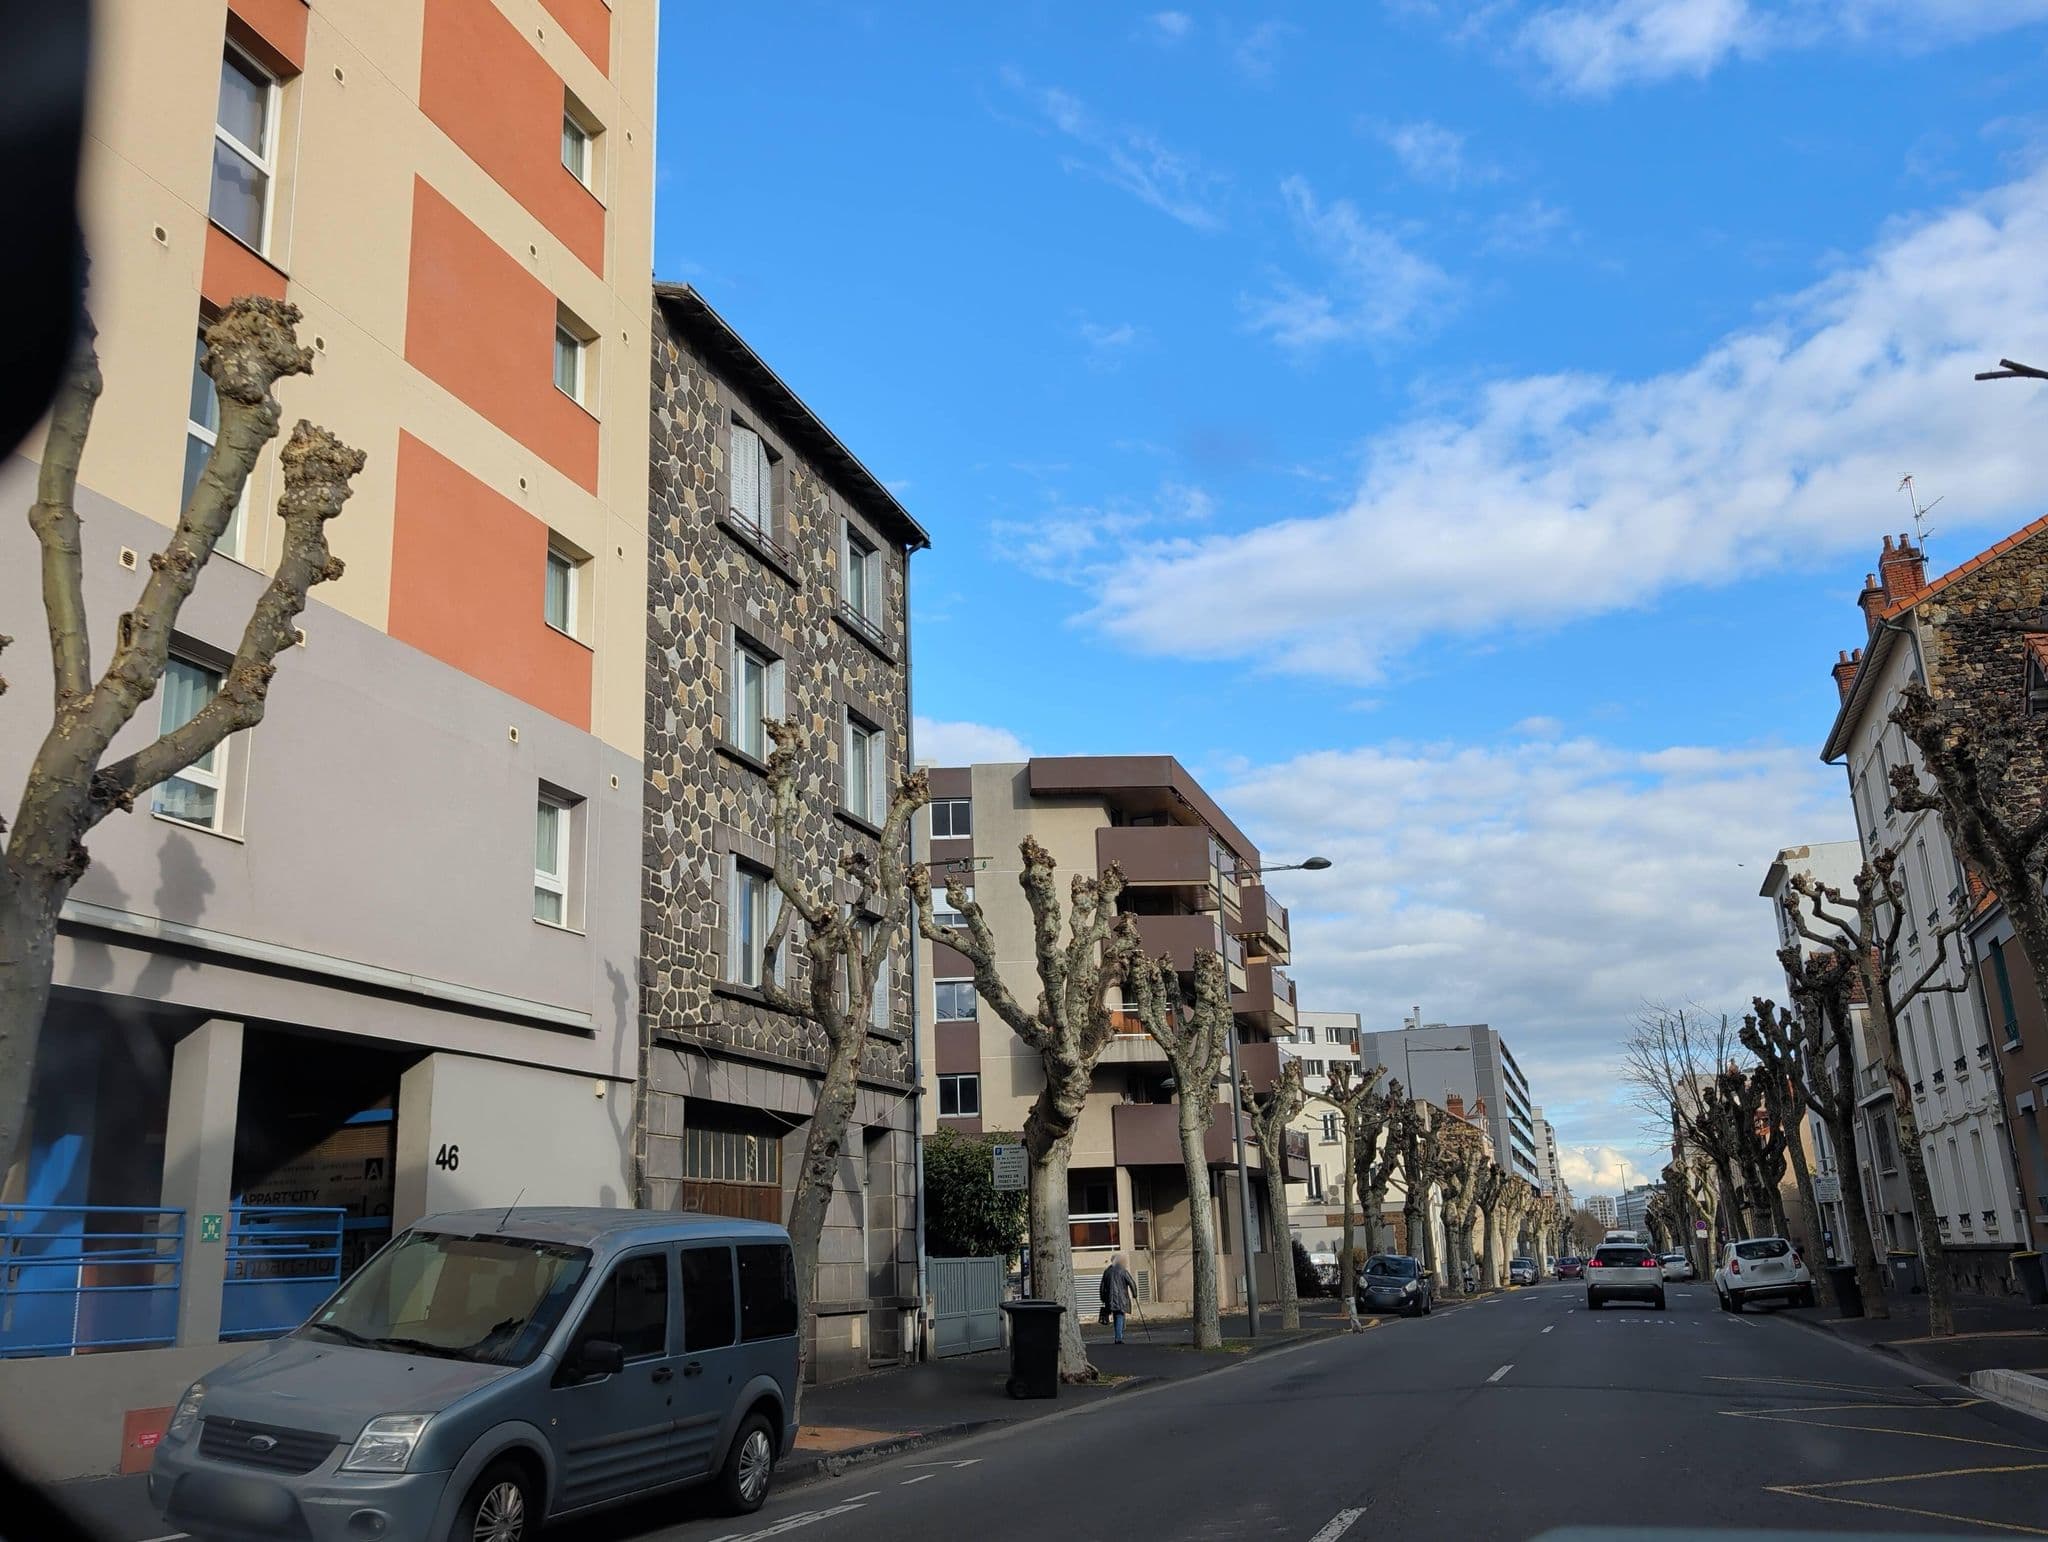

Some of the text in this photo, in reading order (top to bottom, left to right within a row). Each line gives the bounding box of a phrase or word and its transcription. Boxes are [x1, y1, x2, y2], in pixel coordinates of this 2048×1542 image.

[436, 1144, 459, 1170] 46
[367, 1159, 383, 1180] A
[241, 1190, 319, 1206] APPART'CITY
